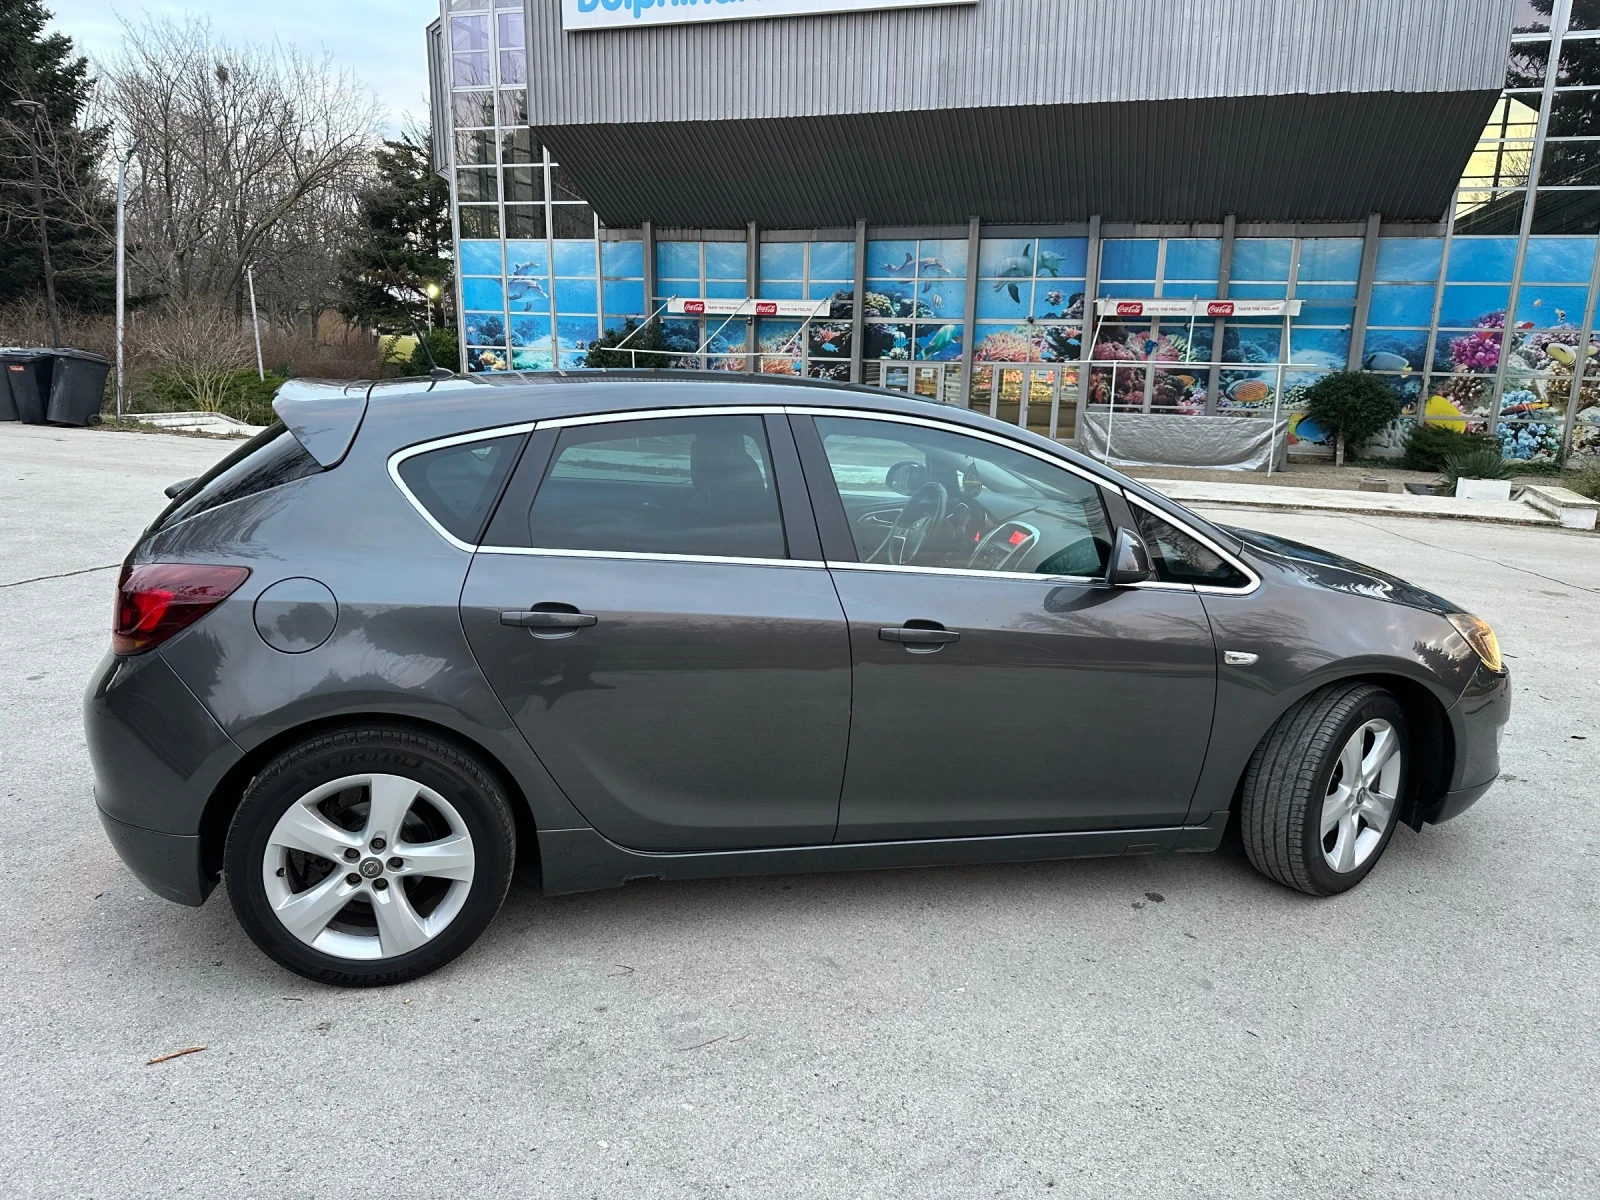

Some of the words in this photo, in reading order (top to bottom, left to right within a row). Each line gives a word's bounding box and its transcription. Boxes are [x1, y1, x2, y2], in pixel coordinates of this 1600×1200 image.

[1117, 304, 1141, 313] Coca-Cola
[1208, 304, 1232, 313] Coca-Cola
[328, 752, 421, 769] MICHELIN
